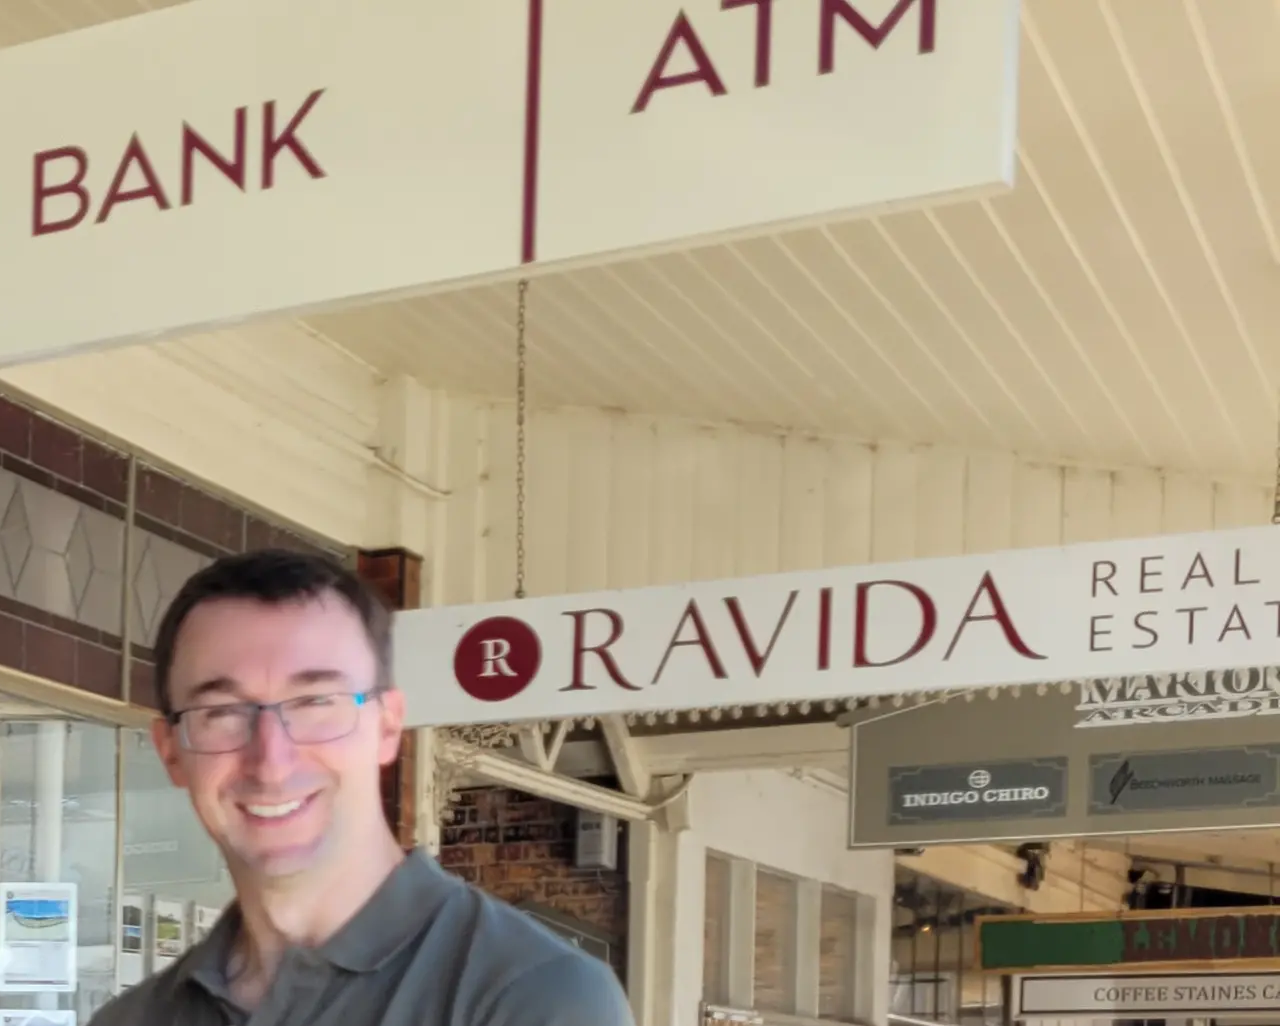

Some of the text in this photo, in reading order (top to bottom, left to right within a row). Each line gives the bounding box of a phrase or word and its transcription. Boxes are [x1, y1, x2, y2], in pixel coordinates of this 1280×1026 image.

[629, 0, 937, 114] ATM
[31, 87, 327, 237] BANK
[1092, 548, 1261, 597] REAL
[557, 569, 1049, 693] RAVIDA
[1088, 600, 1280, 653] ESTAT
[1081, 667, 1280, 704] MARIO
[1086, 699, 1280, 721] ARCAD
[903, 786, 1049, 808] INDIGO CHIRO
[1093, 986, 1168, 1002] COFFEE
[1174, 984, 1256, 1001] STAINES
